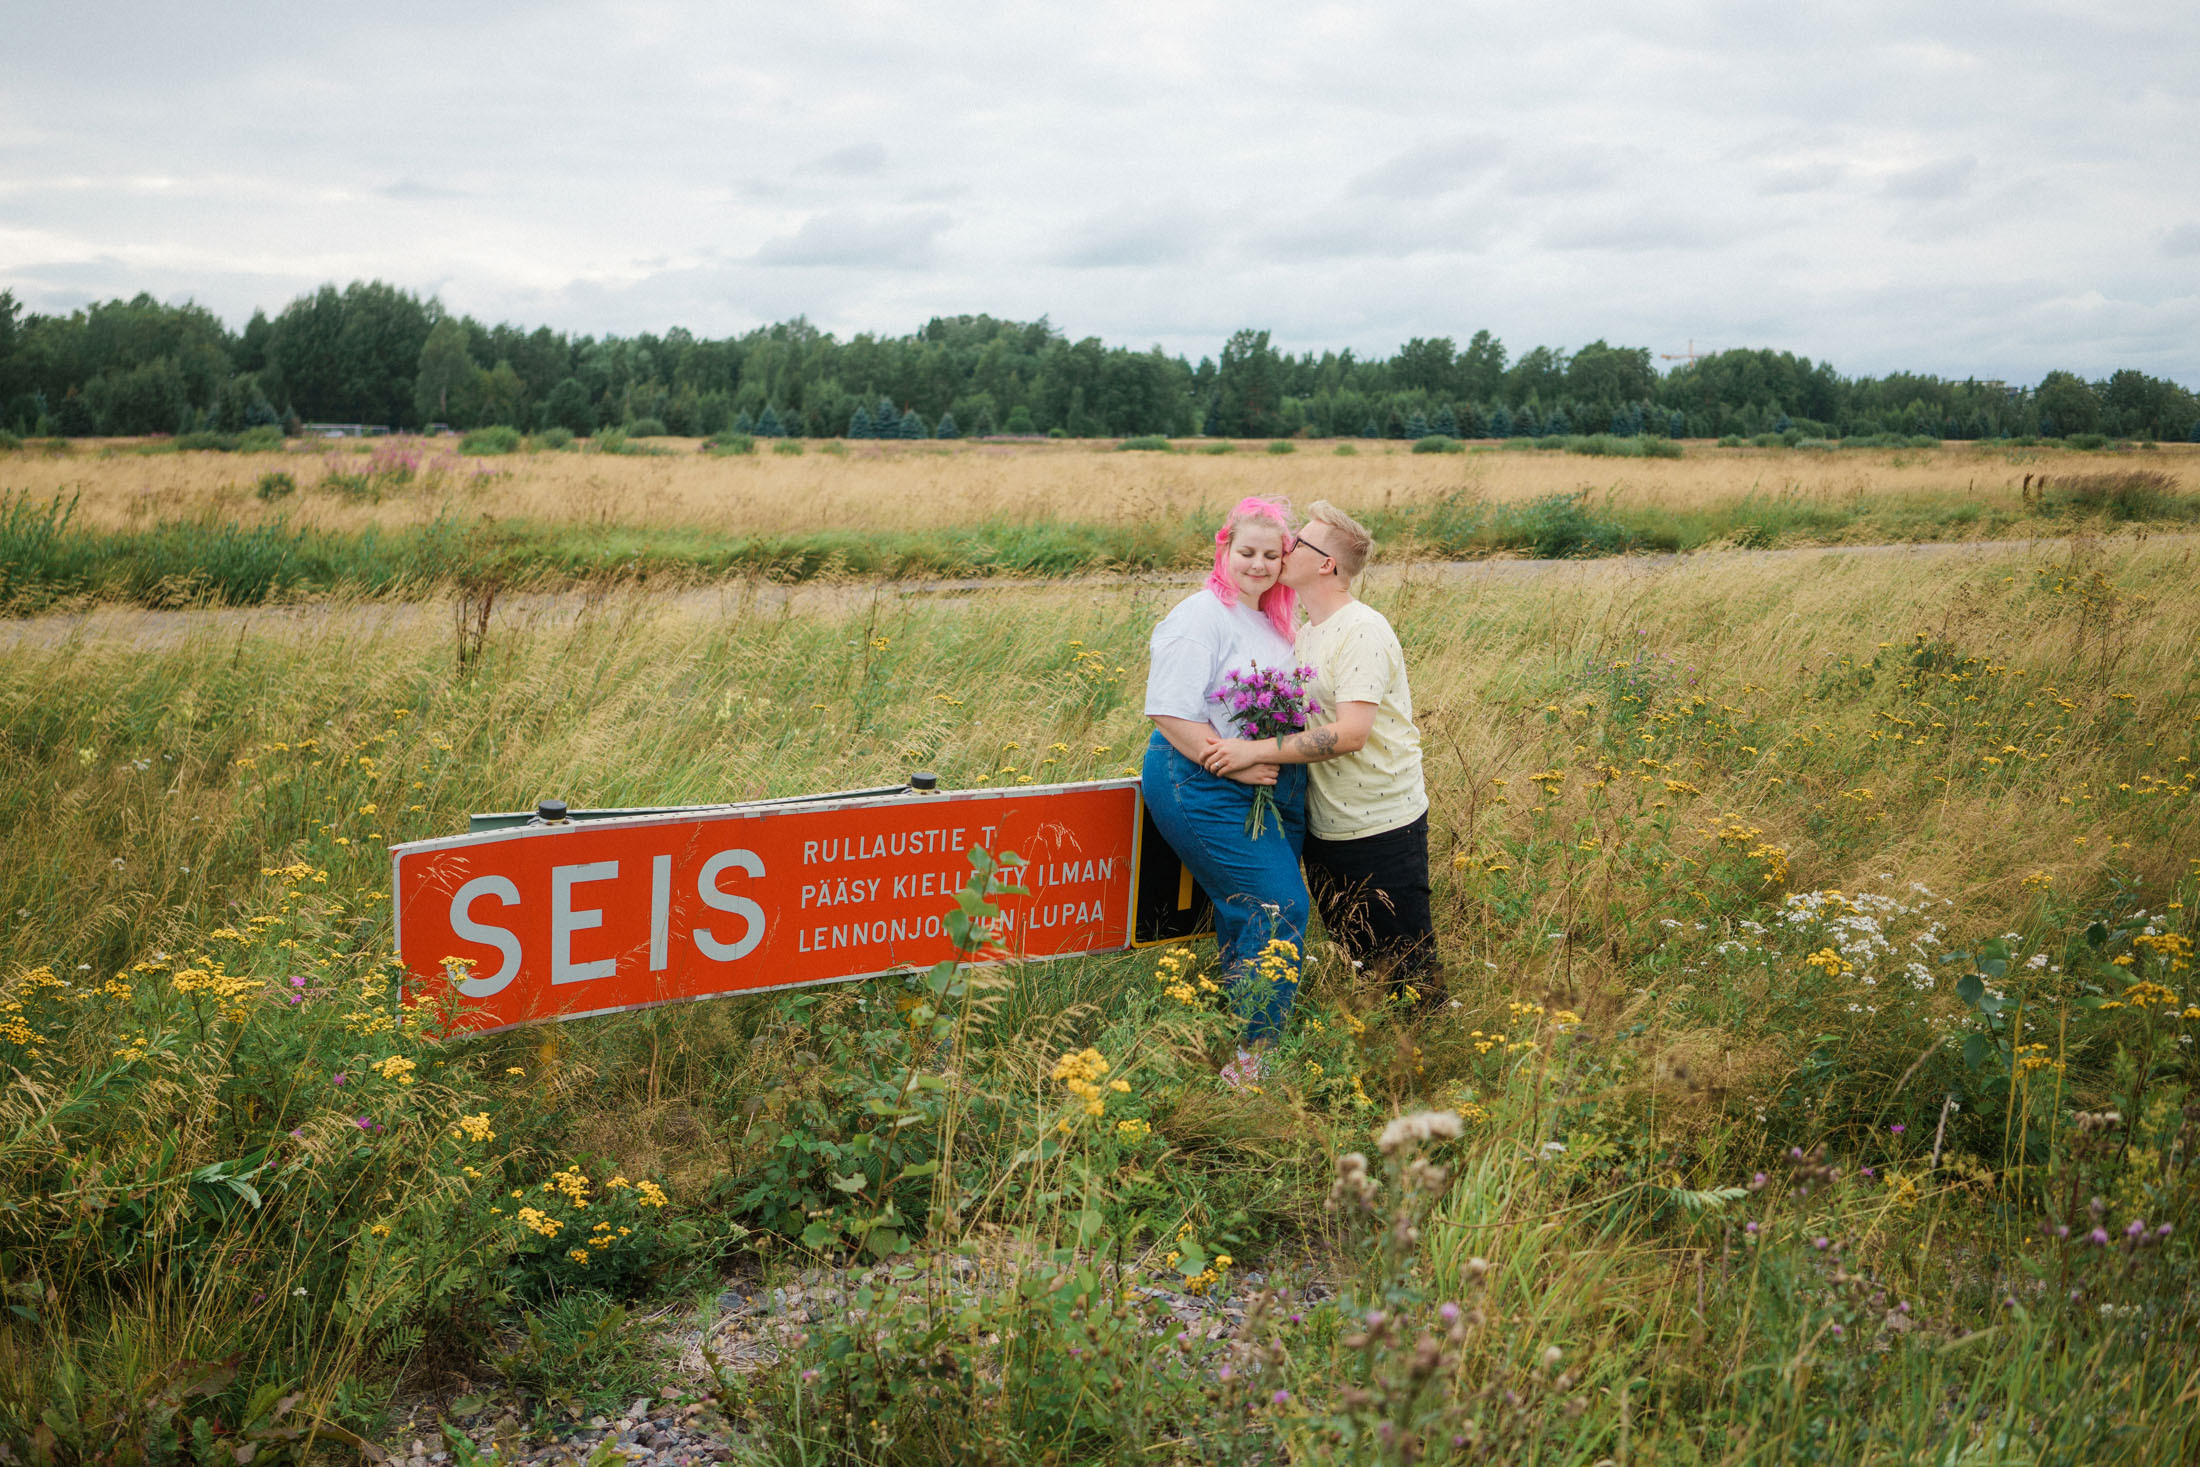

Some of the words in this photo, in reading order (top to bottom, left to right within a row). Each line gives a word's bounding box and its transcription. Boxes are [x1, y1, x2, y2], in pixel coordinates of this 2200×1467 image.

[802, 828, 966, 865] RULLAUSTIE
[981, 826, 996, 850] T
[800, 878, 881, 909] PÄÄSY
[893, 865, 1027, 899] KIELLTY
[1037, 857, 1114, 887] ILMAN
[448, 848, 767, 999] SEIS
[1029, 900, 1105, 930] LUPAA
